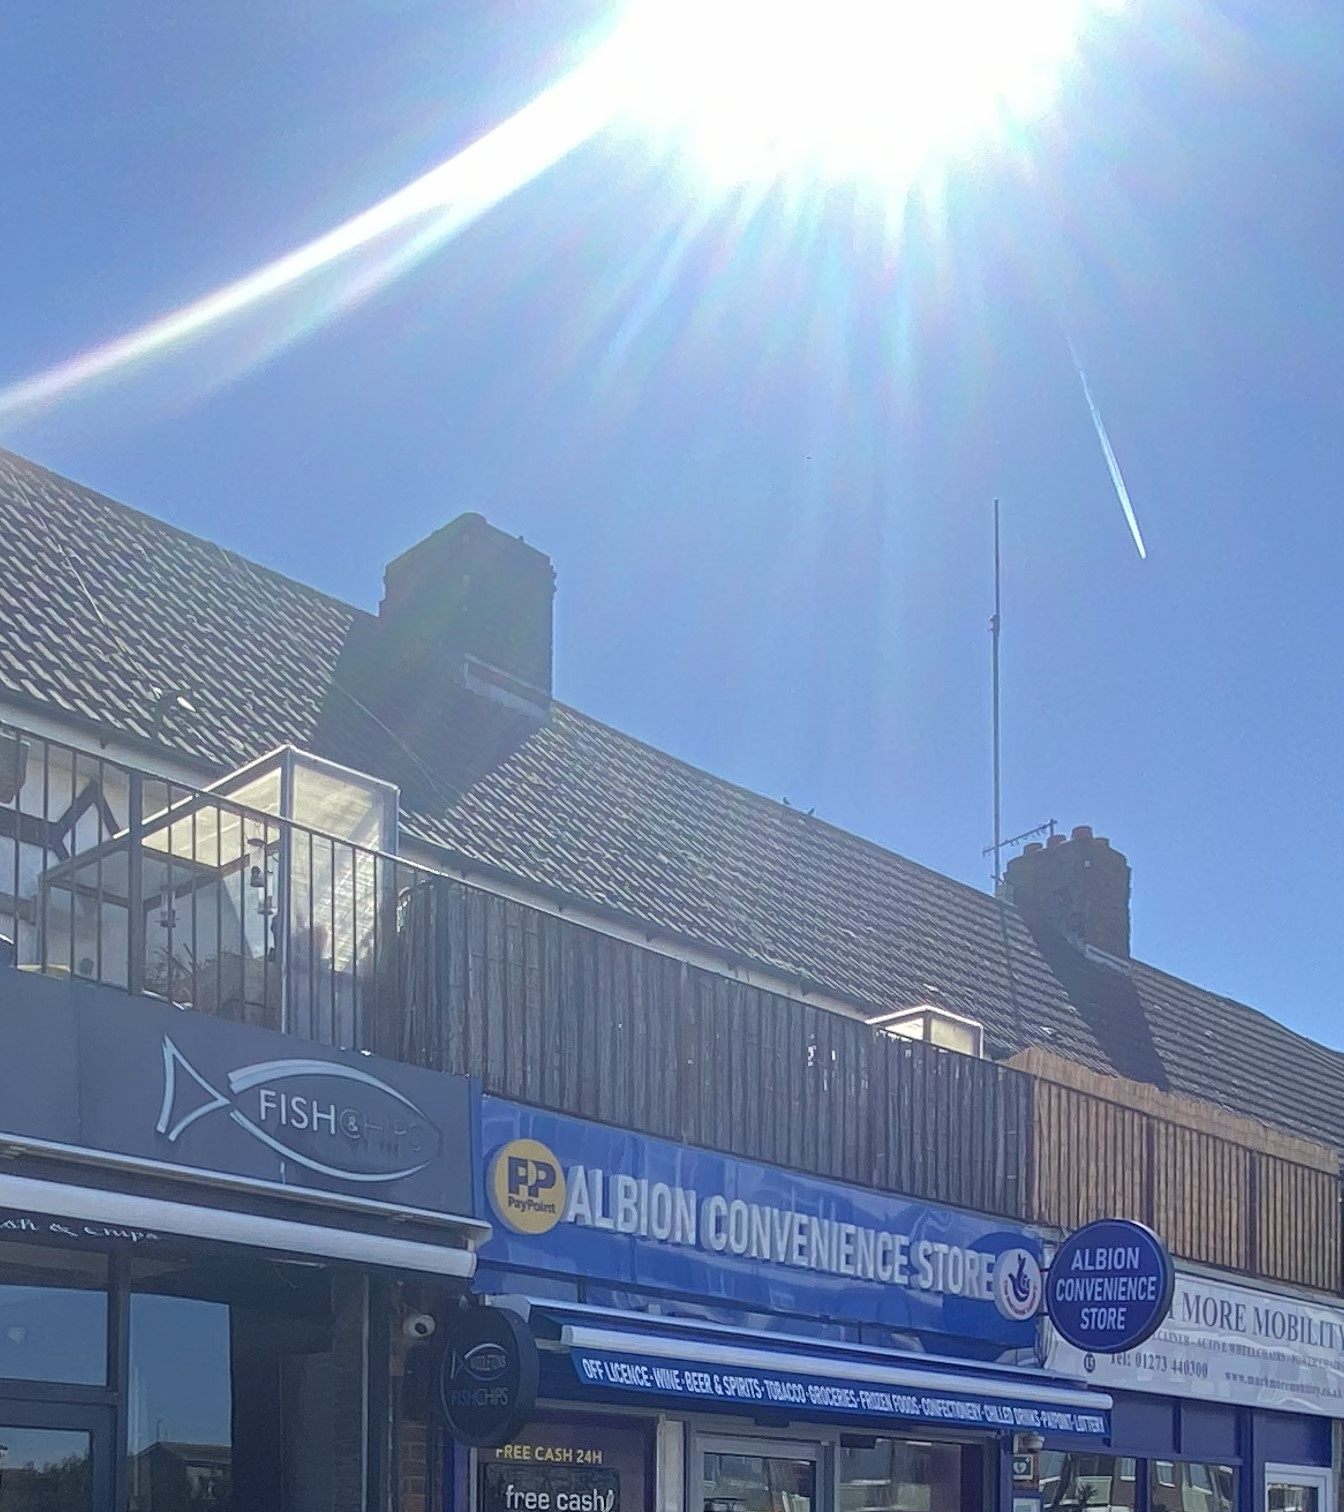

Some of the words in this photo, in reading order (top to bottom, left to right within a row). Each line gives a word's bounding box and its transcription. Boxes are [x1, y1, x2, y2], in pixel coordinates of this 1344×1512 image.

[259, 1088, 336, 1135] FISH
[508, 1195, 557, 1214] PayPoint
[560, 1164, 697, 1247] ALBION
[701, 1194, 910, 1286] CONVENIENCE
[911, 1239, 996, 1301] STORE
[1070, 1246, 1141, 1272] ALBION
[1055, 1275, 1158, 1302] CONVENIENCE
[1079, 1306, 1128, 1331] STORE
[1182, 1290, 1247, 1333] MORE
[581, 1358, 605, 1381] OFF
[1135, 1351, 1168, 1372] 01273
[1170, 1359, 1209, 1379] 440300
[496, 1444, 531, 1461] FREE
[534, 1446, 574, 1463] CASH
[576, 1449, 603, 1464] 24H
[505, 1483, 551, 1511] free
[556, 1488, 605, 1512] cash
